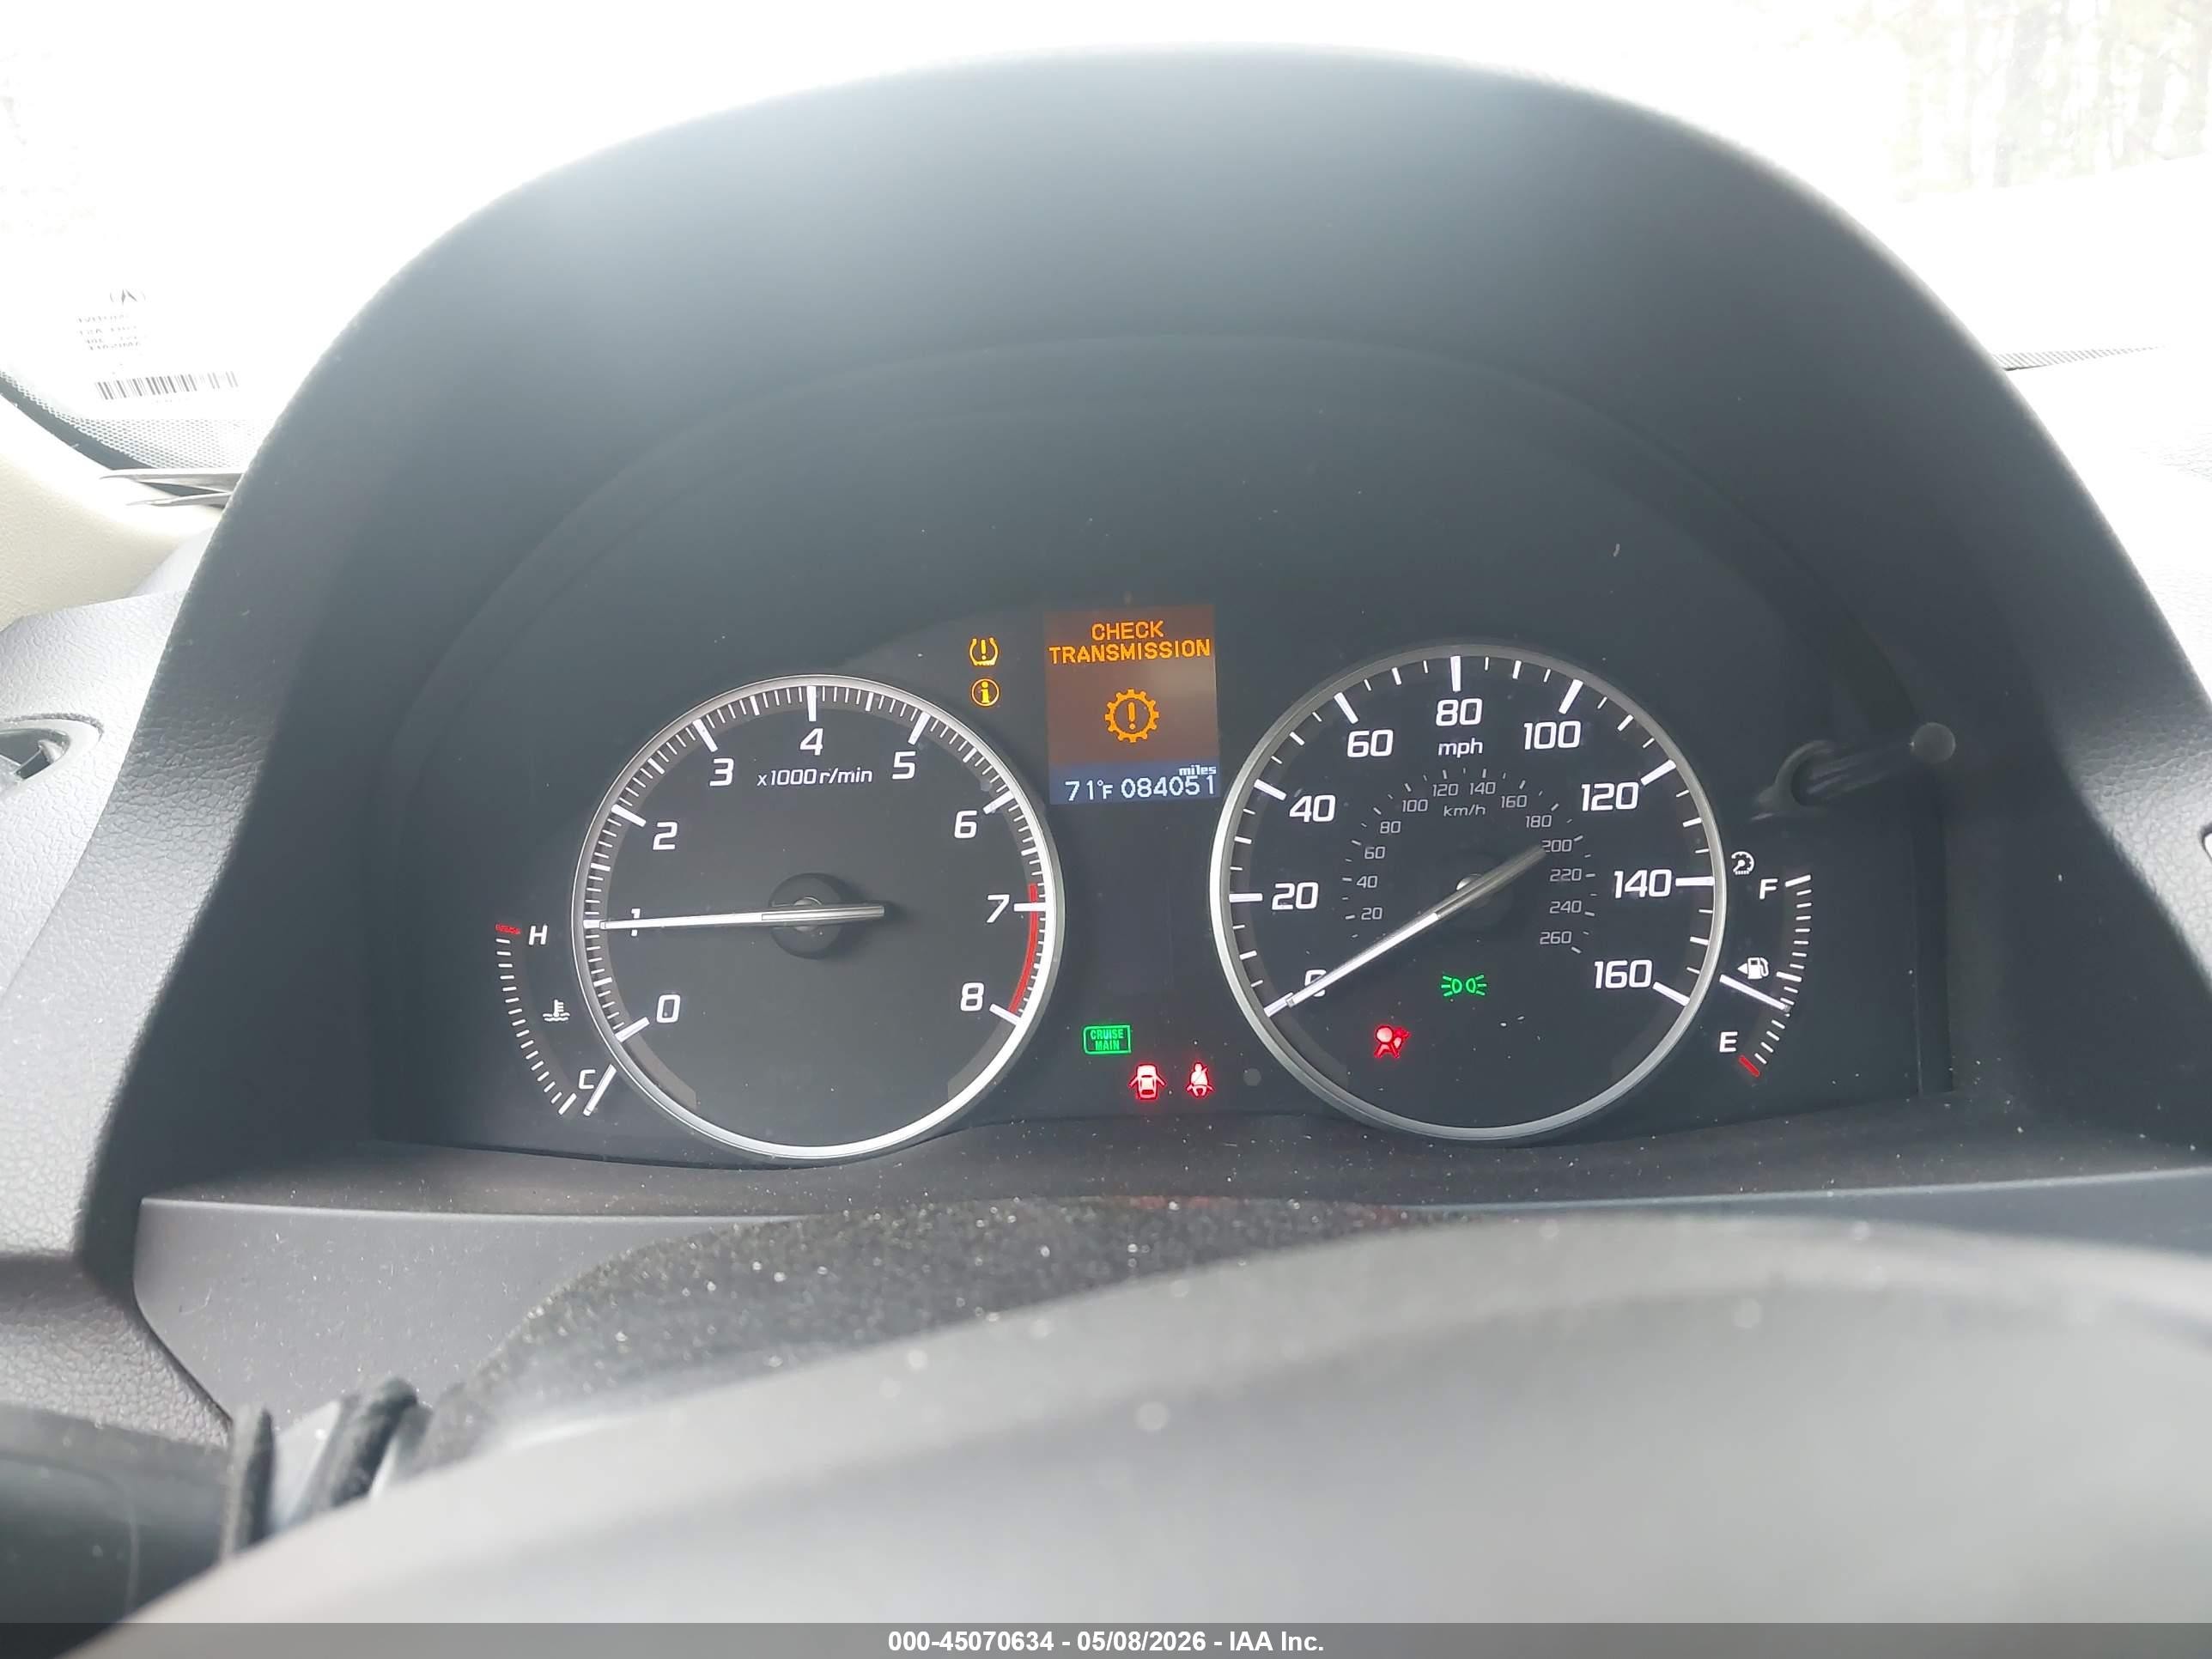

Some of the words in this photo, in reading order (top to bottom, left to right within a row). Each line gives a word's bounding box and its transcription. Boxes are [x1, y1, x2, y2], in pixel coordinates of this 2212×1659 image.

[1091, 620, 1164, 641] CHECK
[1048, 639, 1211, 665] TRANSMISSION
[1435, 697, 1484, 726] 80
[799, 727, 824, 757] 4
[1346, 729, 1395, 758] 60
[1523, 720, 1582, 750] 100
[1437, 737, 1484, 758] mph
[708, 757, 735, 787] 3
[891, 750, 916, 780] 5
[1178, 764, 1217, 775] miles
[1120, 775, 1214, 799] 084051
[1431, 782, 1459, 797] 120
[1469, 781, 1496, 795] 140
[1581, 781, 1639, 811] 120
[1288, 794, 1336, 823] 40
[1401, 799, 1428, 812] 100
[1443, 804, 1486, 817] km/h
[1500, 794, 1528, 809] 160
[953, 810, 978, 839] 6
[1379, 820, 1401, 834] 80
[1525, 814, 1552, 828] 180
[652, 821, 678, 850] 2
[1541, 839, 1572, 853] 200
[1364, 846, 1386, 860] 60
[1356, 875, 1378, 889] 40
[1549, 868, 1583, 882] 220
[1613, 868, 1673, 899] 140
[1271, 881, 1319, 910] 20
[1759, 878, 1778, 900] F
[986, 894, 1011, 923] 7
[1360, 907, 1383, 921] 20
[1549, 900, 1583, 914] 240
[527, 923, 549, 946] H
[1539, 931, 1572, 945] 260
[1594, 959, 1653, 989] 160
[959, 981, 986, 1012] 8
[656, 994, 681, 1024] 0
[1090, 1029, 1124, 1040] CRUISE
[1095, 1040, 1121, 1051] MAIN
[1719, 1031, 1738, 1053] E
[578, 1069, 596, 1090] C
